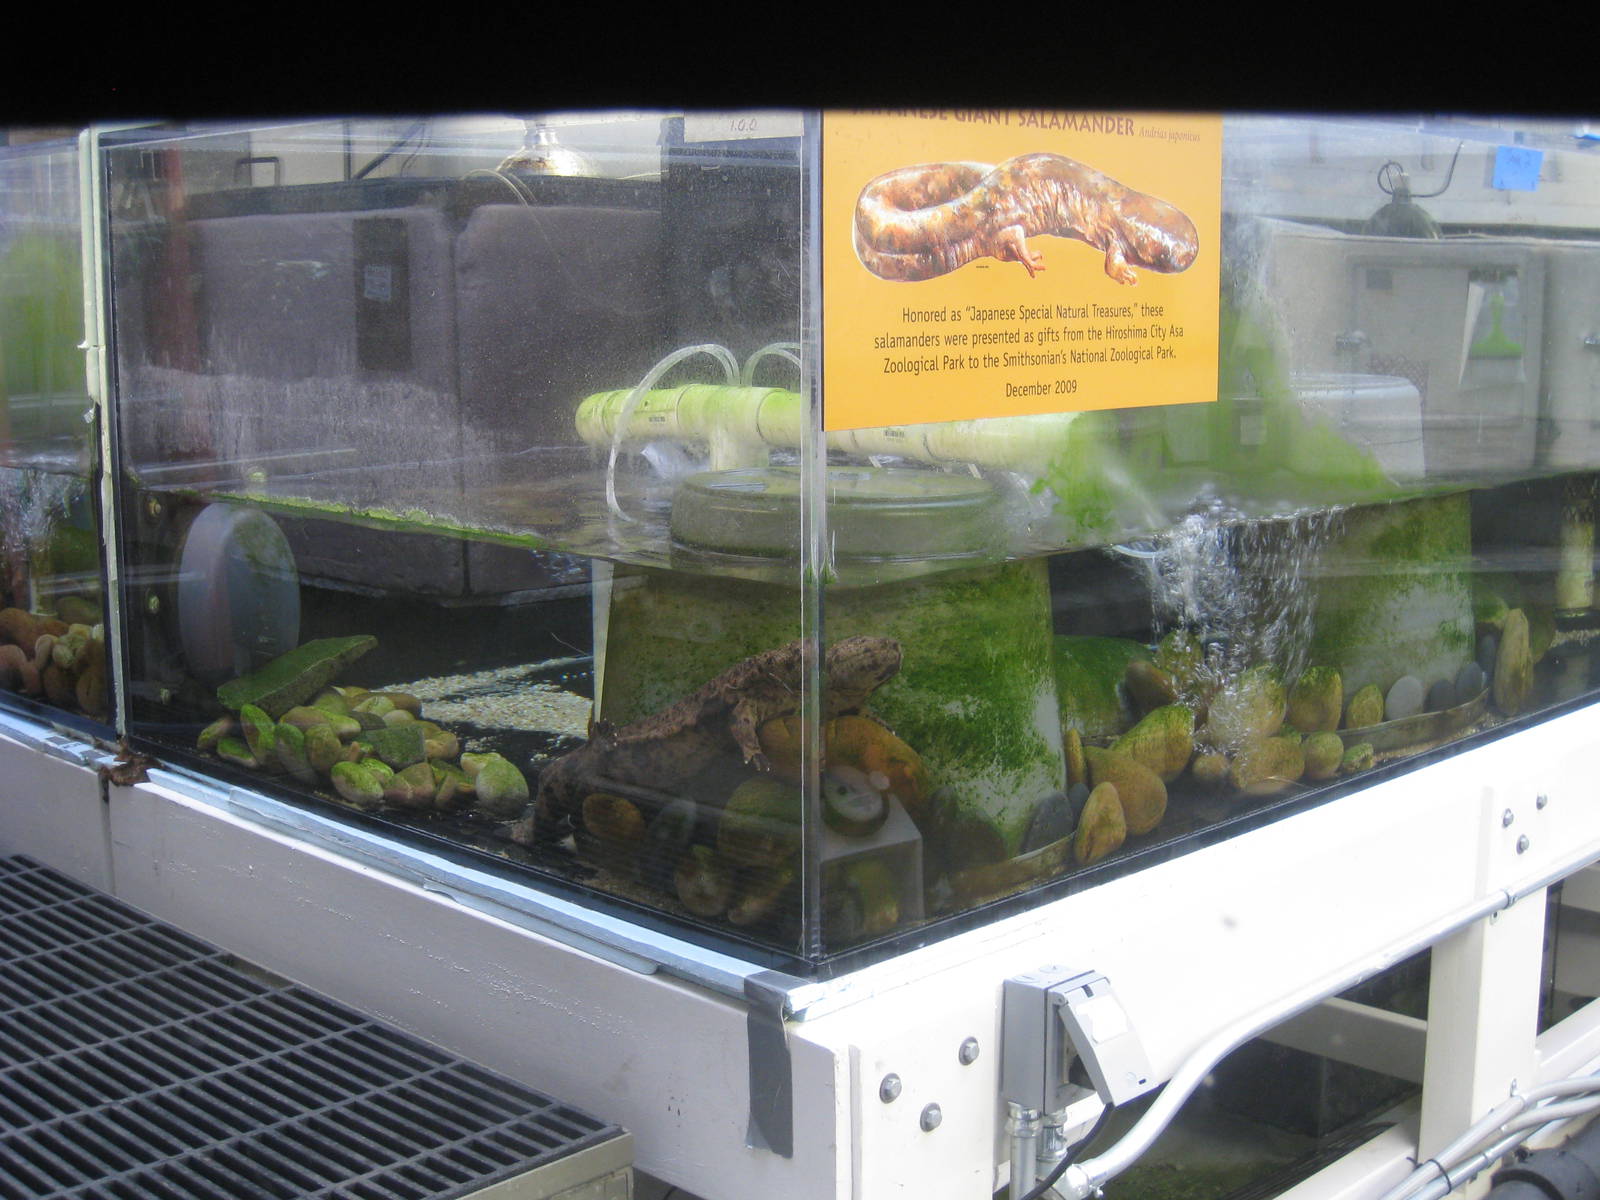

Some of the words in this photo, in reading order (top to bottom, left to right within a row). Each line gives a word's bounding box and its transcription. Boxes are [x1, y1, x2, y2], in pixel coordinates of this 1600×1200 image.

[953, 107, 1012, 125] GIANT
[1018, 108, 1135, 136] SALAMANDER
[1138, 126, 1167, 139] Andrias
[902, 306, 947, 323] Honored
[950, 310, 962, 322] as
[965, 305, 1016, 325] “Japanese
[1019, 304, 1053, 324] Special
[1056, 303, 1089, 319] Natural
[1092, 302, 1138, 319] Treasures,”
[1141, 303, 1164, 317] these
[874, 331, 940, 349] salamanders
[944, 334, 968, 346] were
[972, 328, 1020, 349] presented
[1024, 332, 1034, 343] as
[1037, 327, 1060, 346] gifts
[1063, 326, 1084, 342] from
[1087, 326, 1102, 340] the
[1105, 324, 1148, 340] Hiroshima
[1150, 324, 1166, 342] City
[1169, 324, 1184, 337] Asa
[884, 355, 939, 376] Zoological
[943, 354, 965, 371] Park
[968, 355, 979, 369] to
[983, 353, 1000, 368] the
[1003, 350, 1067, 368] Smithsonian's
[1070, 347, 1107, 364] National
[1110, 346, 1153, 365] Zoological
[1156, 345, 1177, 360] Park.
[1005, 381, 1051, 398] December
[1055, 379, 1077, 395] 2009
